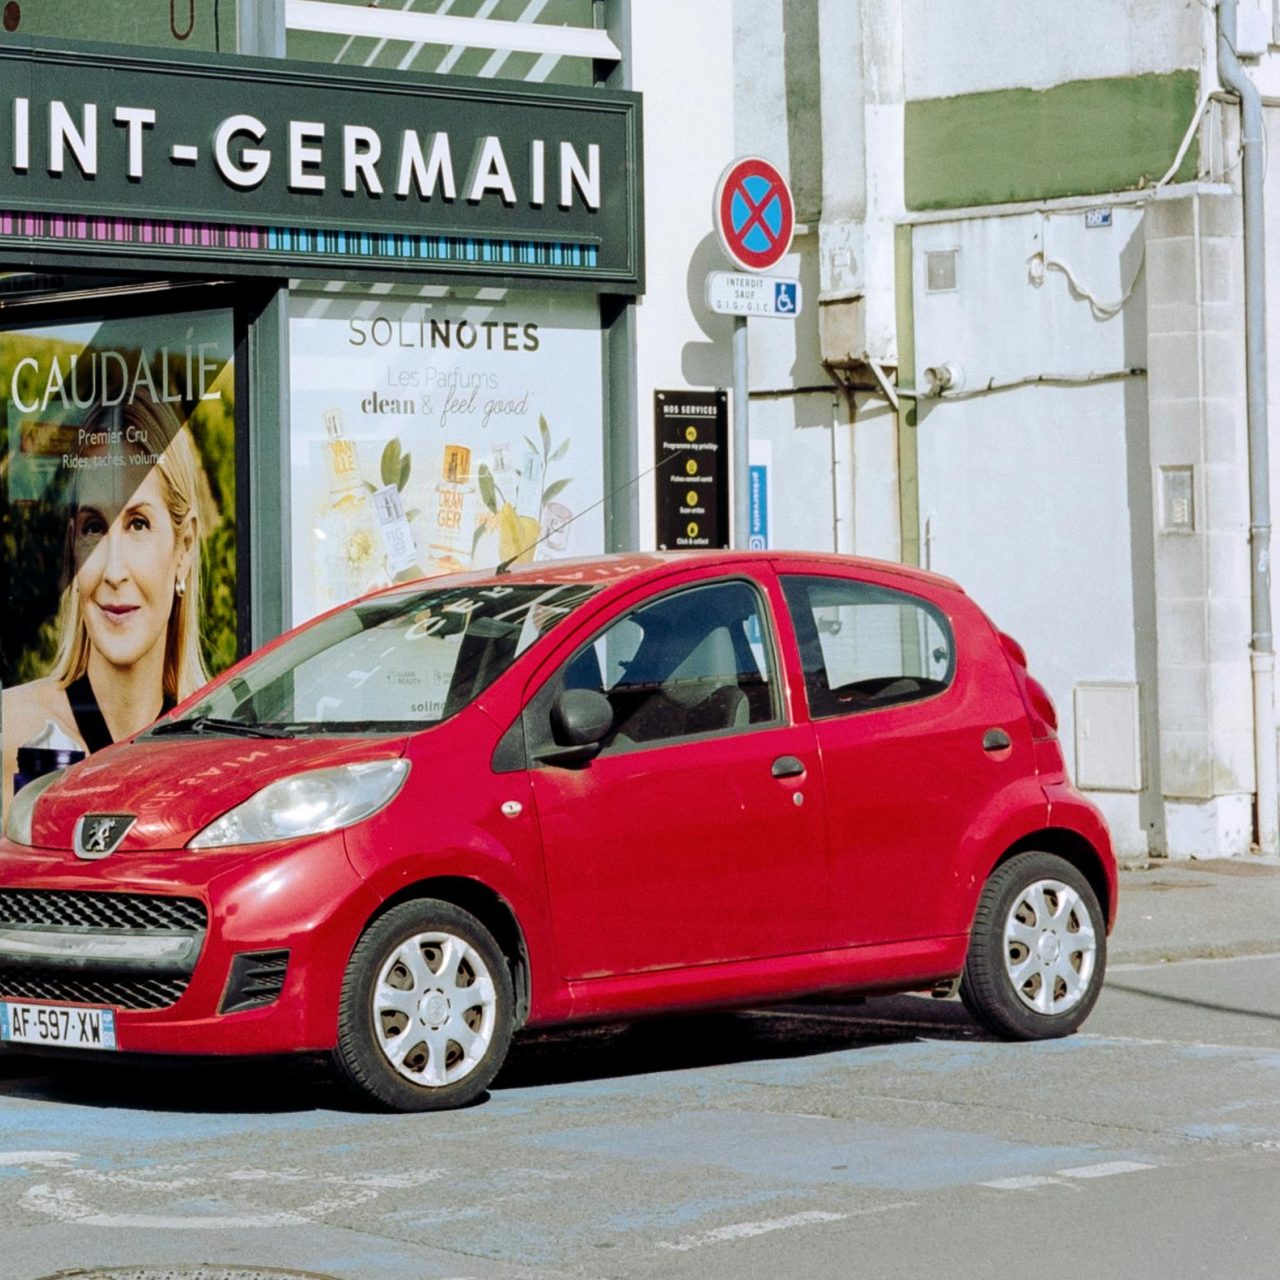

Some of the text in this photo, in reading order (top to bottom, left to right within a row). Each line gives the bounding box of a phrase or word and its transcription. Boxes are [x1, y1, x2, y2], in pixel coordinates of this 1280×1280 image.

[726, 277, 763, 289] INTERDIT
[735, 290, 755, 299] SAUF
[349, 317, 540, 352] SOLINOTES
[387, 366, 499, 390] Les Parfums
[361, 384, 529, 428] clean & feel good
[663, 405, 717, 415] NOS SERVICES
[78, 425, 148, 446] Premier Cru
[62, 453, 90, 469] Rides,
[129, 451, 165, 465] volume
